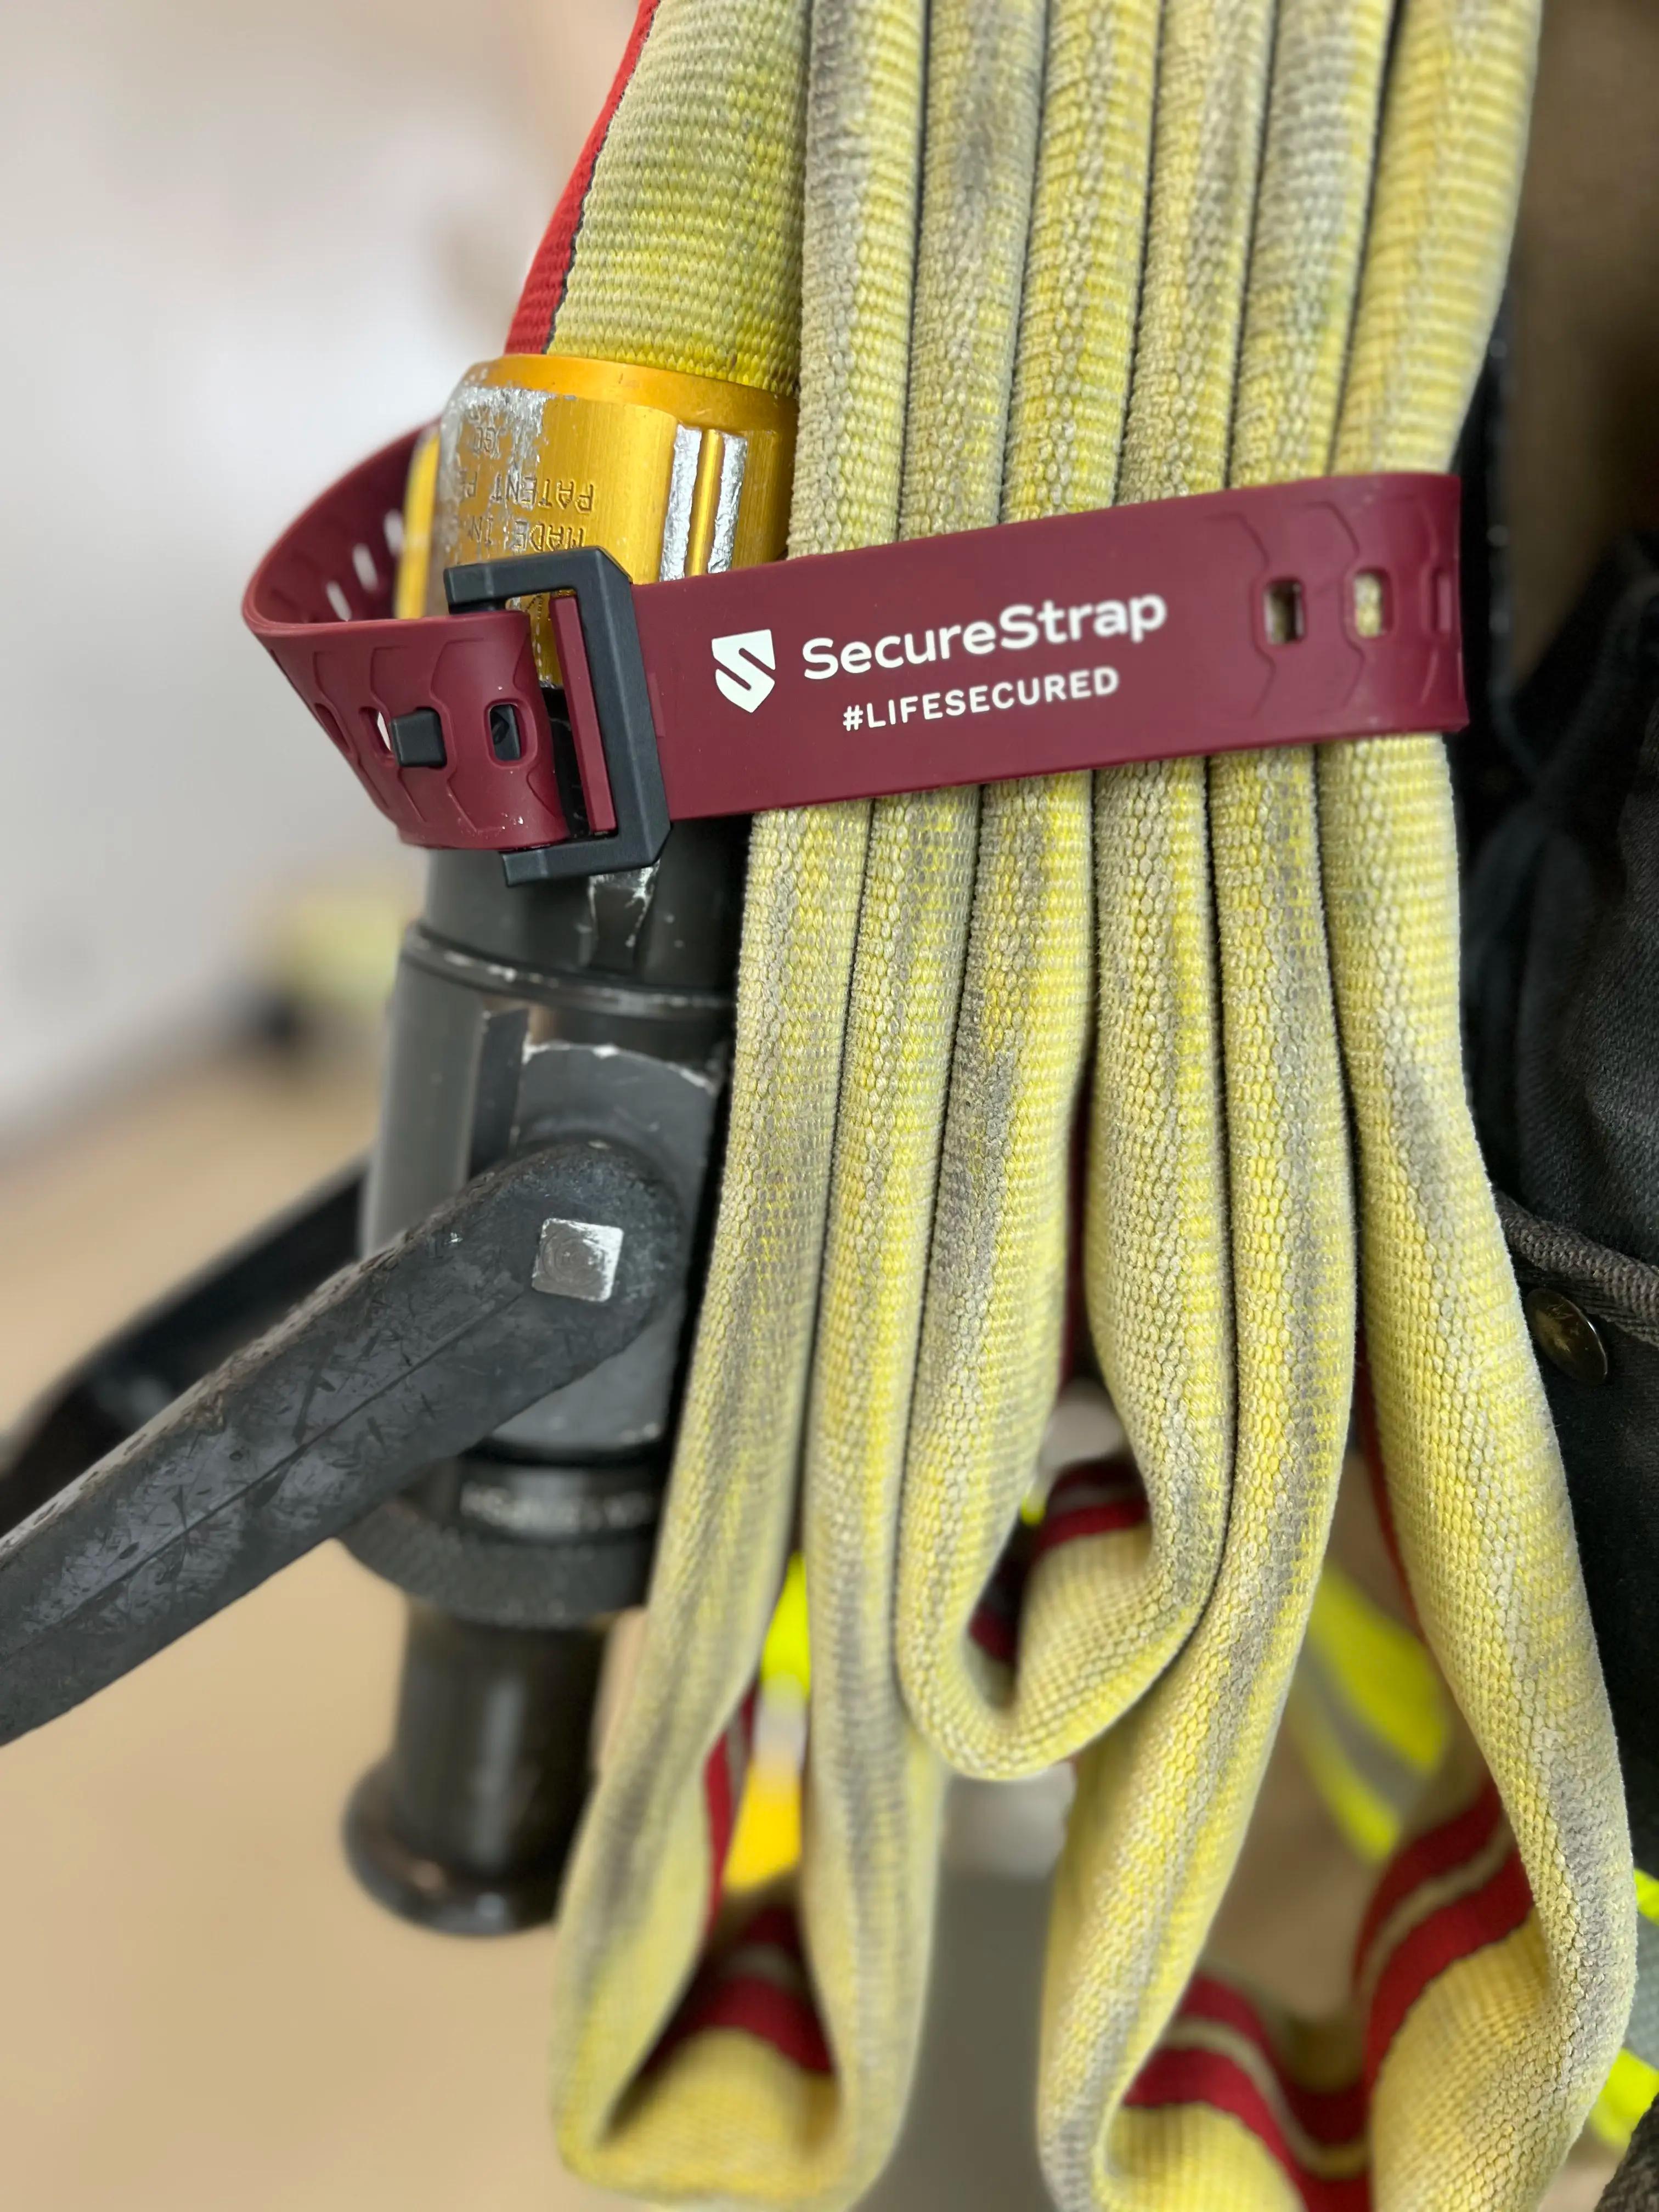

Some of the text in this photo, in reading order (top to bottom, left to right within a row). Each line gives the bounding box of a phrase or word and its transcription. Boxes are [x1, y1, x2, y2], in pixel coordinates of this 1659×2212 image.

[489, 473, 595, 514] PATENT
[512, 519, 586, 552] MADE
[802, 594, 1167, 680] SecureStrap
[842, 666, 1119, 732] #LIFESECURED
